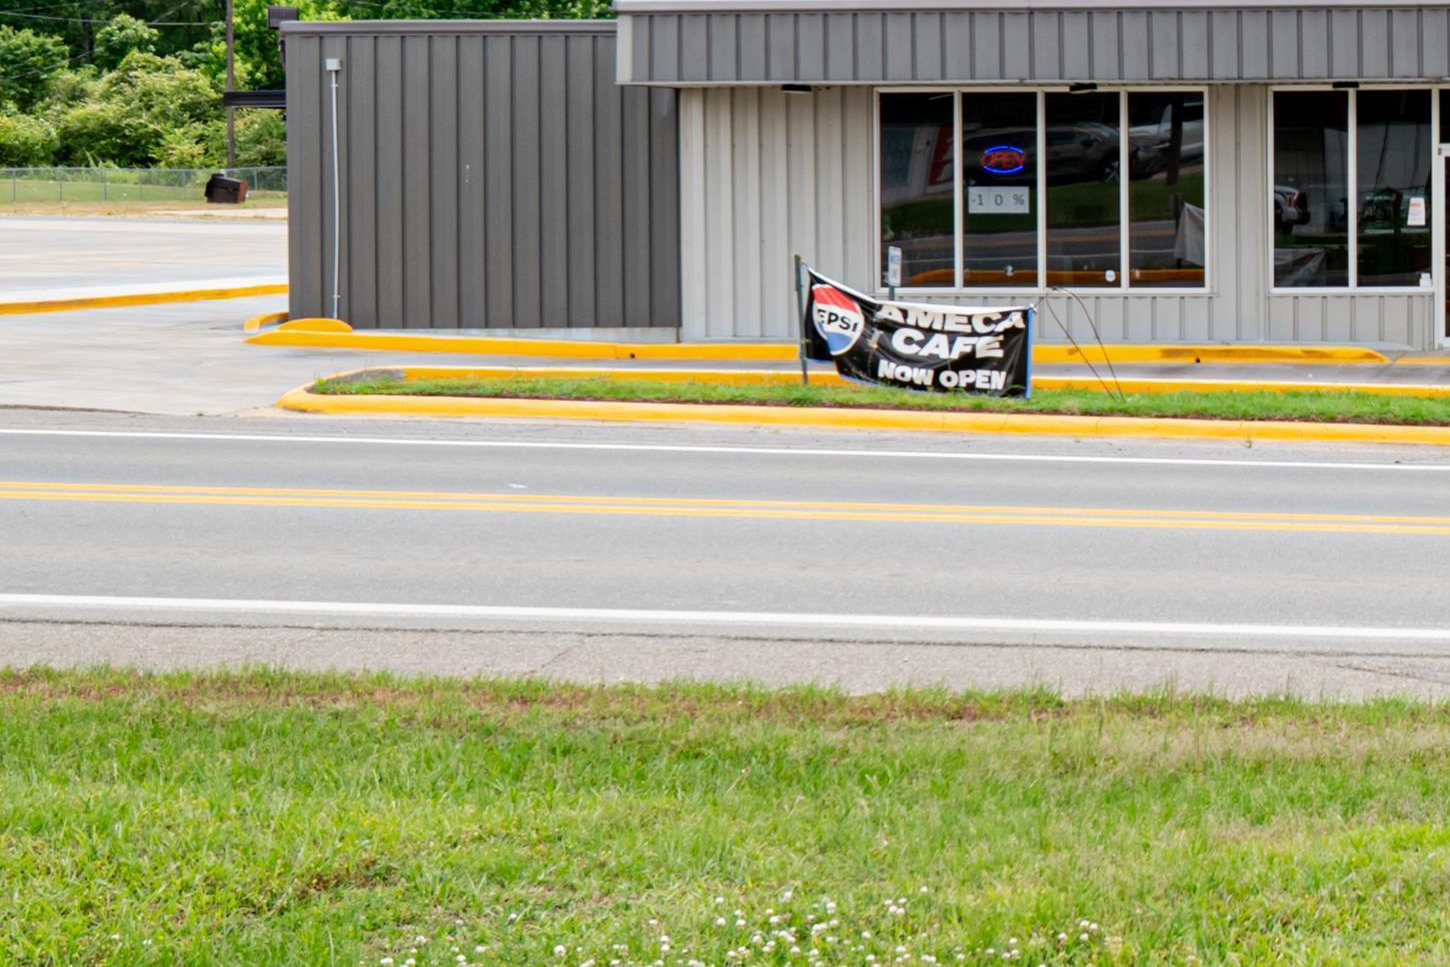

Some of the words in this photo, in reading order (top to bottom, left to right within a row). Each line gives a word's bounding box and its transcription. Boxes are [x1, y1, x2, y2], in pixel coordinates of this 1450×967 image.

[980, 151, 1025, 168] OPEN
[875, 304, 1026, 334] AMECA
[891, 327, 1005, 360] CAFE
[878, 359, 934, 387] NOW
[938, 369, 1008, 391] OPEN
